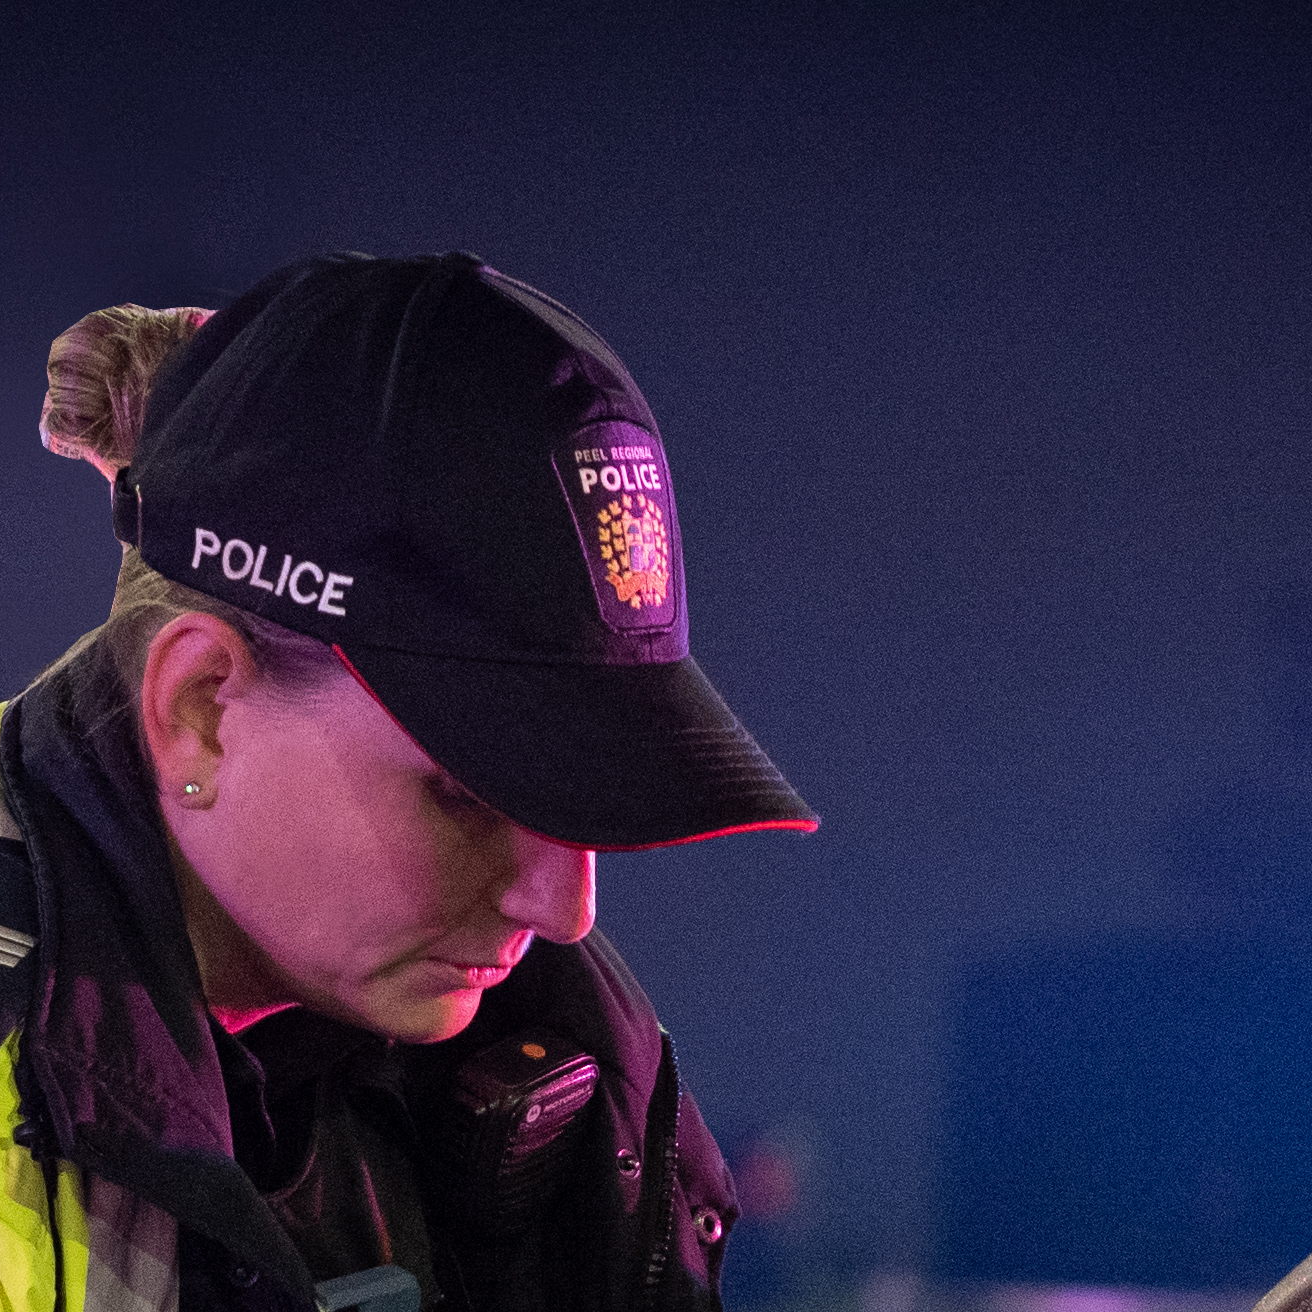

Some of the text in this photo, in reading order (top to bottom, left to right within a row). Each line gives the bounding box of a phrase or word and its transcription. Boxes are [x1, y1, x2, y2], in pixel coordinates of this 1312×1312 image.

[574, 445, 654, 464] PEEL REGIONAL
[578, 463, 662, 494] POLICE
[191, 527, 354, 617] POLICE
